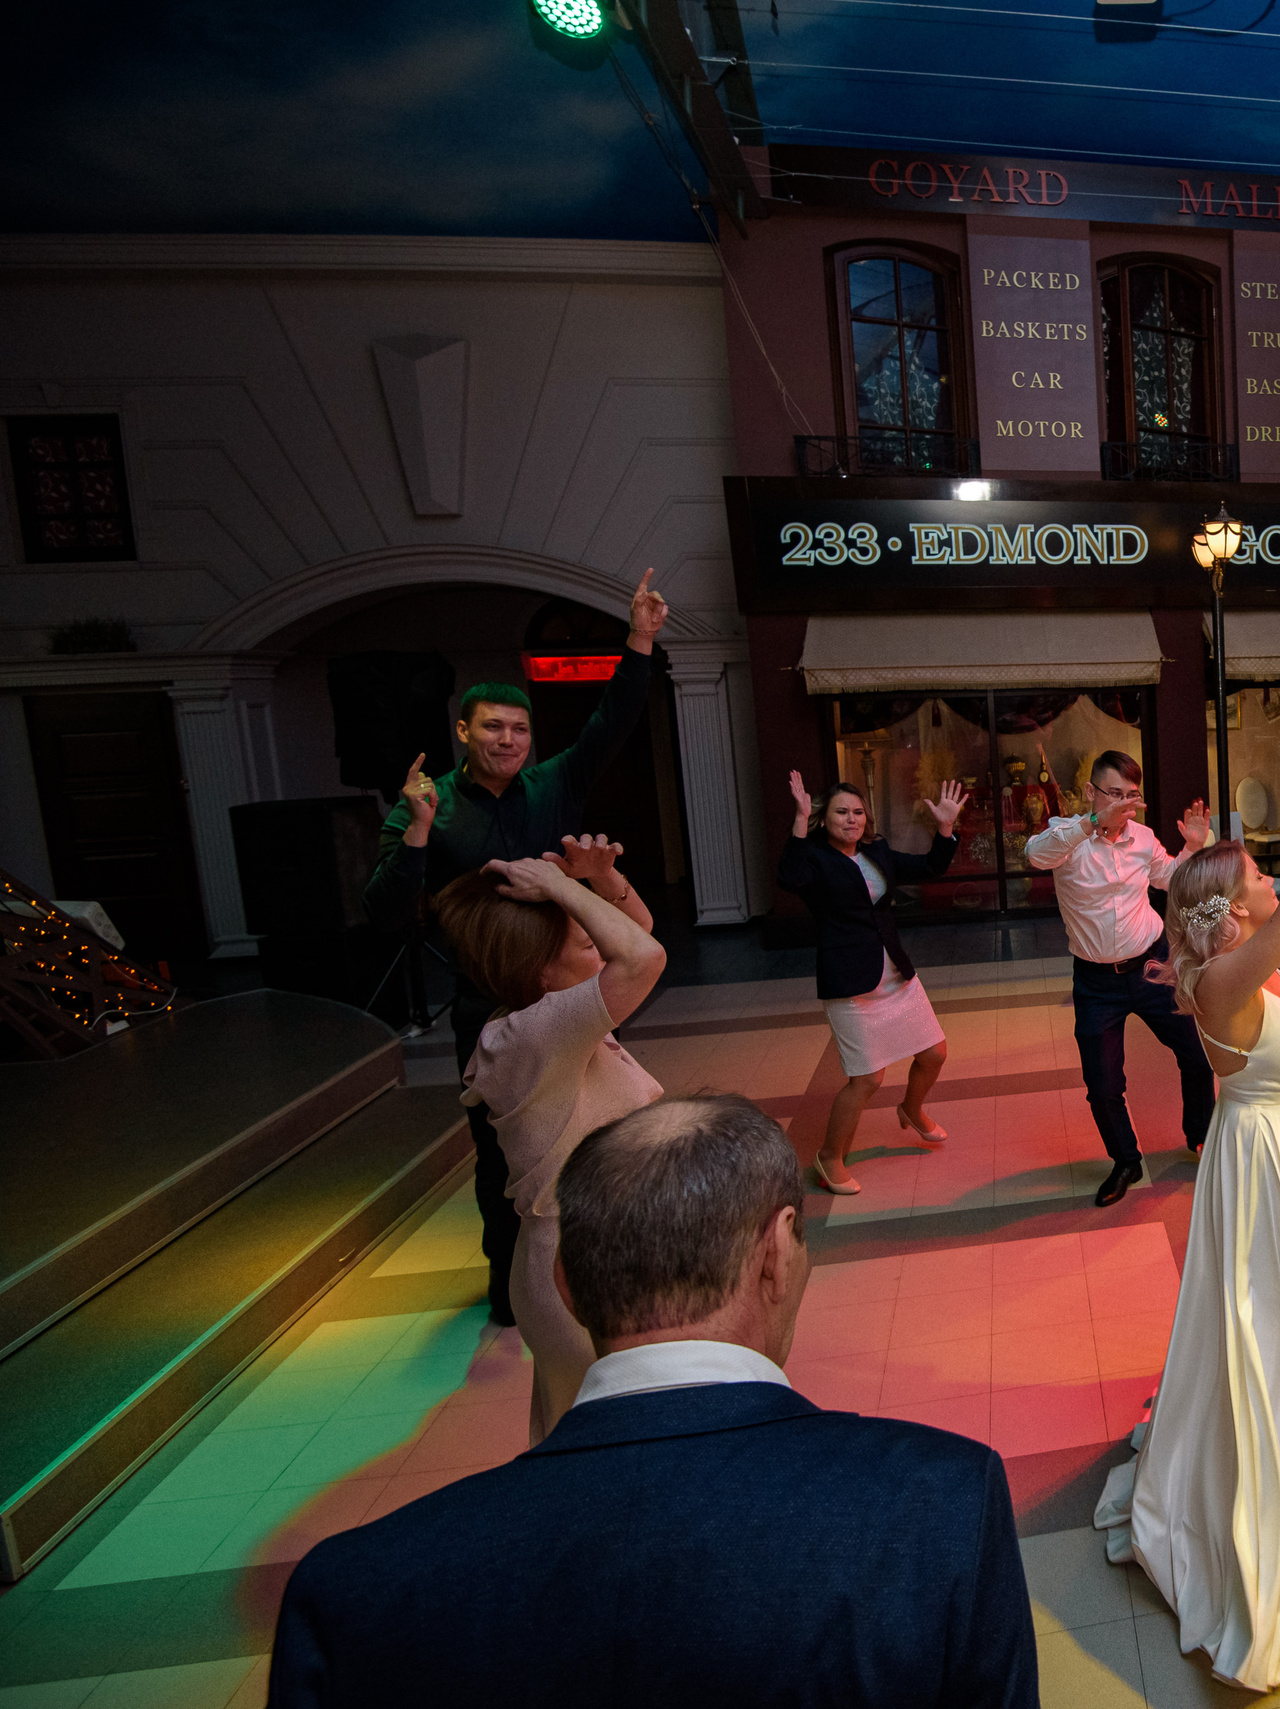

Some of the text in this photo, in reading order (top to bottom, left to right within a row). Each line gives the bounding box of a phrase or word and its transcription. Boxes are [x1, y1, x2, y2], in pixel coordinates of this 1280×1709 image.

[868, 158, 1069, 206] GOYARD
[983, 268, 1080, 291] PACKED
[980, 320, 1088, 342] BASKETS
[1011, 371, 1064, 390] CAR
[996, 420, 1085, 439] MOTOR
[909, 523, 1149, 565] EDMOND
